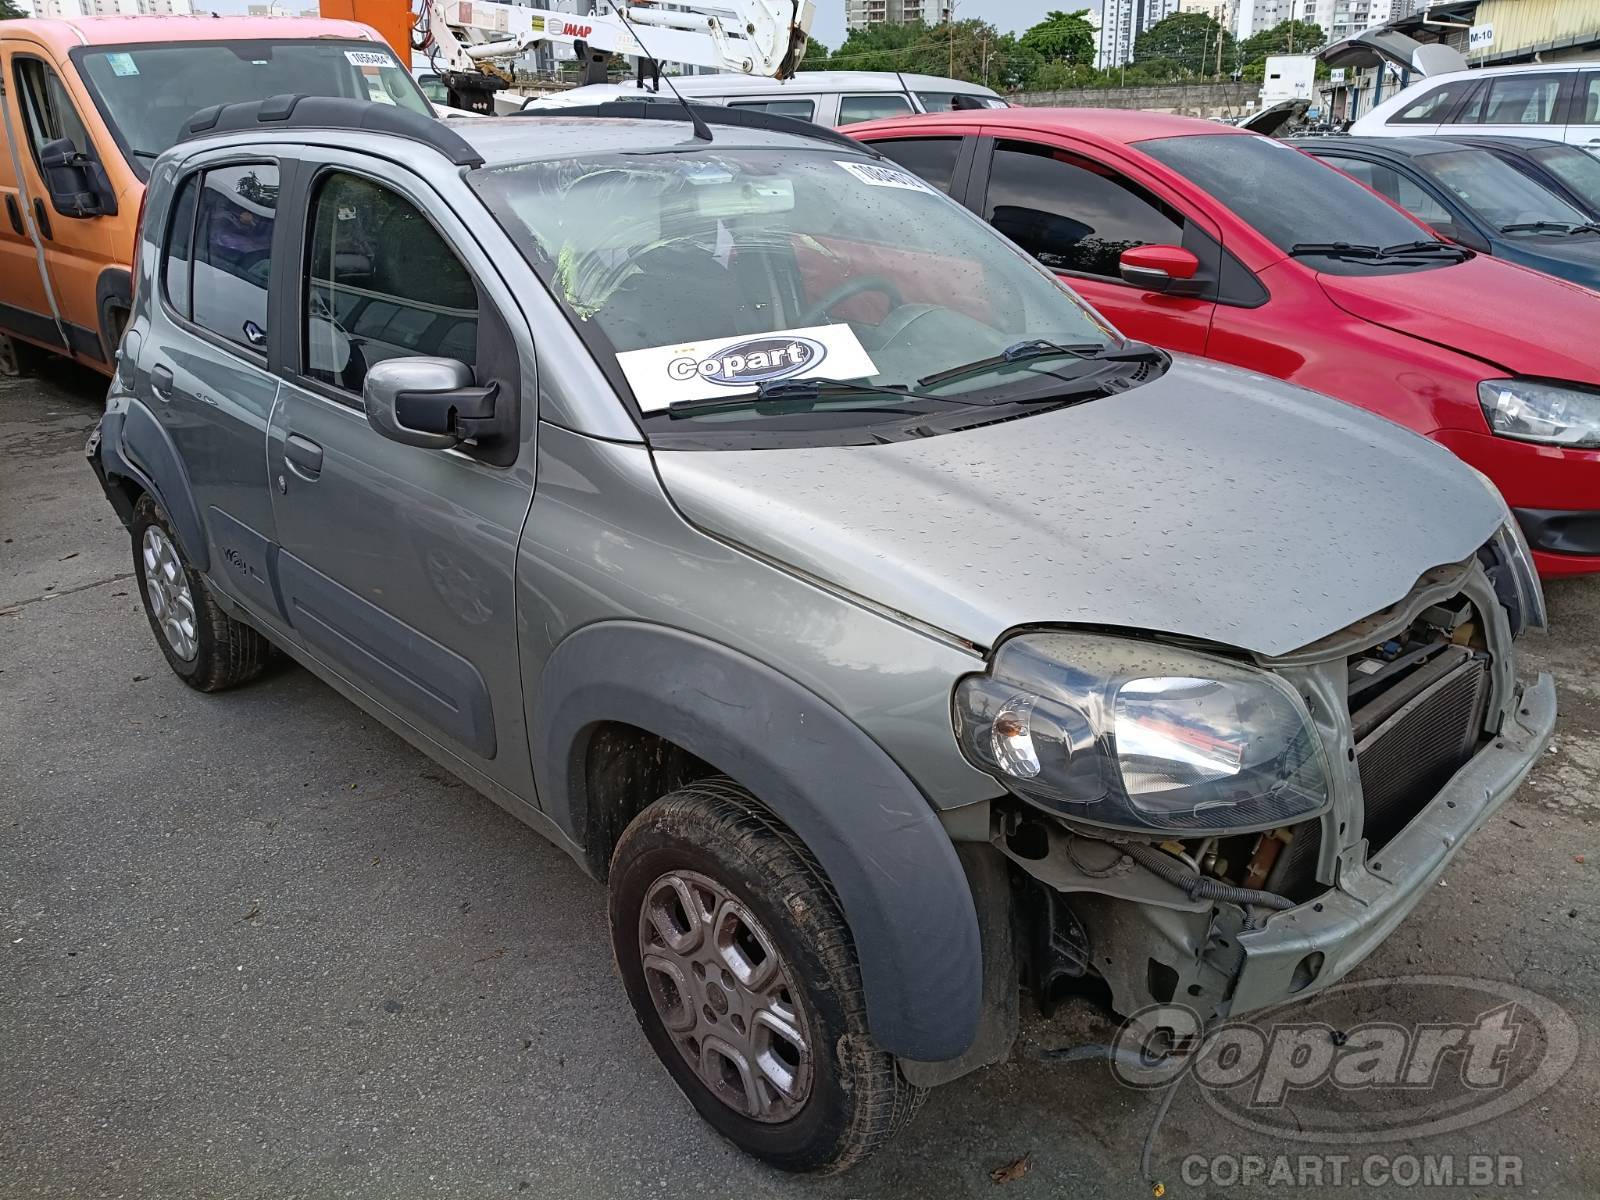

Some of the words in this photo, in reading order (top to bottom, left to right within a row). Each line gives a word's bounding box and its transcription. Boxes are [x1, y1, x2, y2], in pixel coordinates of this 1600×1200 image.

[562, 22, 592, 38] IMAP
[1470, 29, 1493, 43] M-10
[667, 341, 805, 380] Copart
